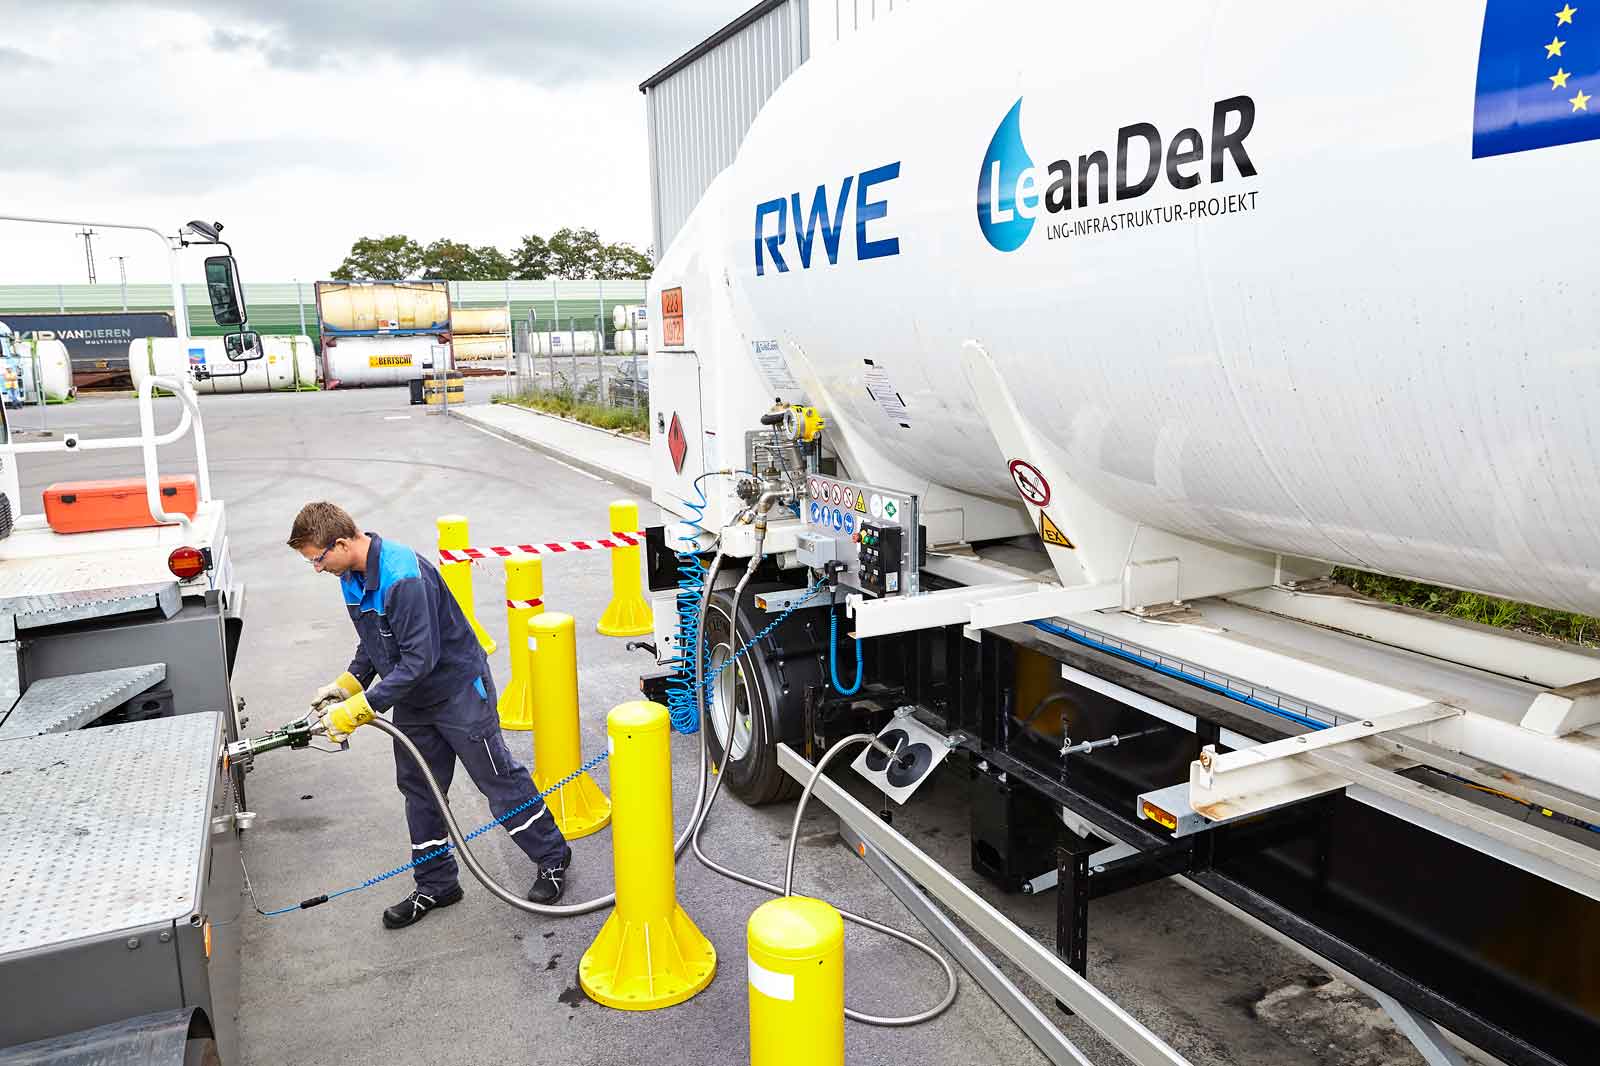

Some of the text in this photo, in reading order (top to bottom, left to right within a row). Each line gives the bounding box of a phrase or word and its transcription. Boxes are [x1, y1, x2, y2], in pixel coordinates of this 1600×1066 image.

[989, 95, 1258, 226] LeanDeR
[756, 161, 901, 277] RWE
[1047, 191, 1260, 241] LNG-INFRASTRUKTUR-PROJEKT
[666, 293, 679, 313] 223
[378, 356, 411, 365] BERTSCHI
[1045, 529, 1063, 543] EX
